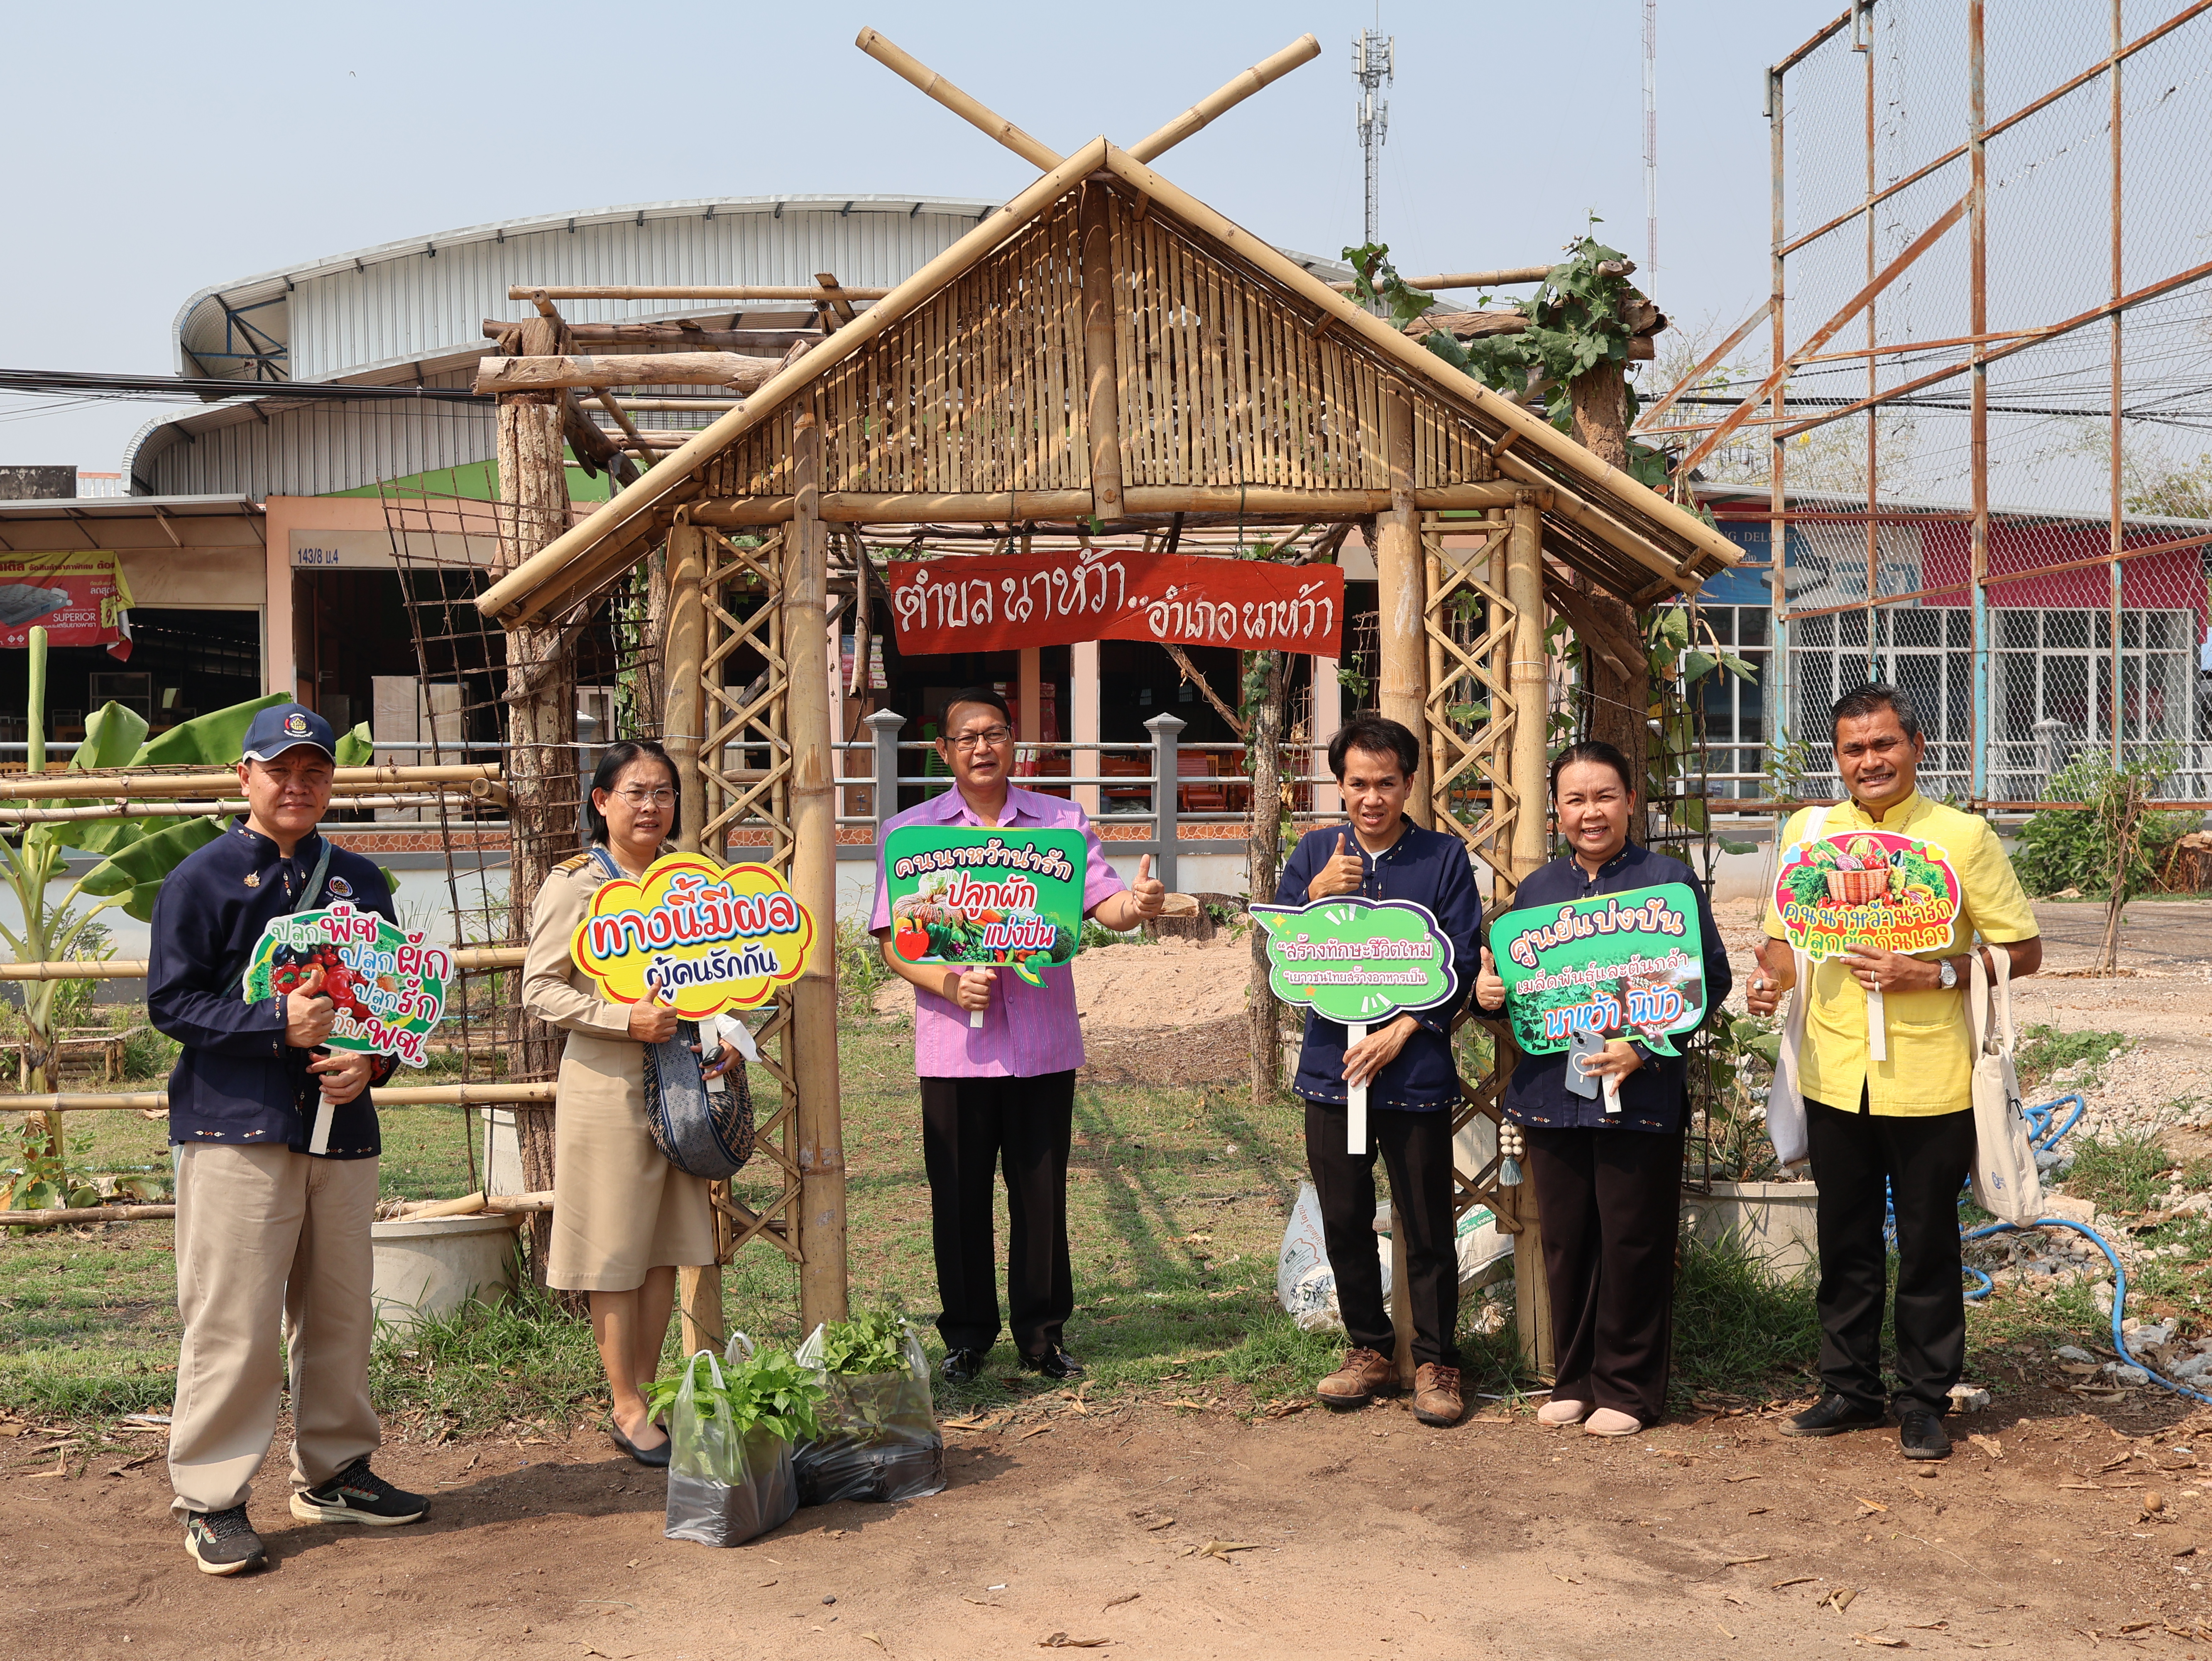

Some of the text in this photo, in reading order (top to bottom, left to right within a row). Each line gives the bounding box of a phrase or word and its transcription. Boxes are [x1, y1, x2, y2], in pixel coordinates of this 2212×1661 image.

[298, 548, 338, 564] 143/8 ม.4
[1744, 532, 1794, 543] DELE
[53, 612, 96, 622] SUPERIOR
[896, 839, 1072, 880] คนนาหว้าน่ารัก
[593, 877, 794, 953] ทางนี้มีผล
[949, 872, 1035, 917] ปลูกผัก
[1785, 896, 1952, 928] คนนาหว้าน่ารัก
[272, 906, 377, 951] ปลูกพืช
[985, 917, 1055, 947] แบ่งปัน
[1510, 899, 1684, 966] ศูนย์แบ่งปัน
[340, 931, 448, 979] ปลูกผัก
[647, 944, 777, 1000] ผู้คนรักกัน
[1516, 948, 1688, 994] เมล็ดพันธุ์และต้นกล้า
[354, 978, 439, 1021] ปลูกรัก
[1547, 994, 1617, 1036] นาหว้า
